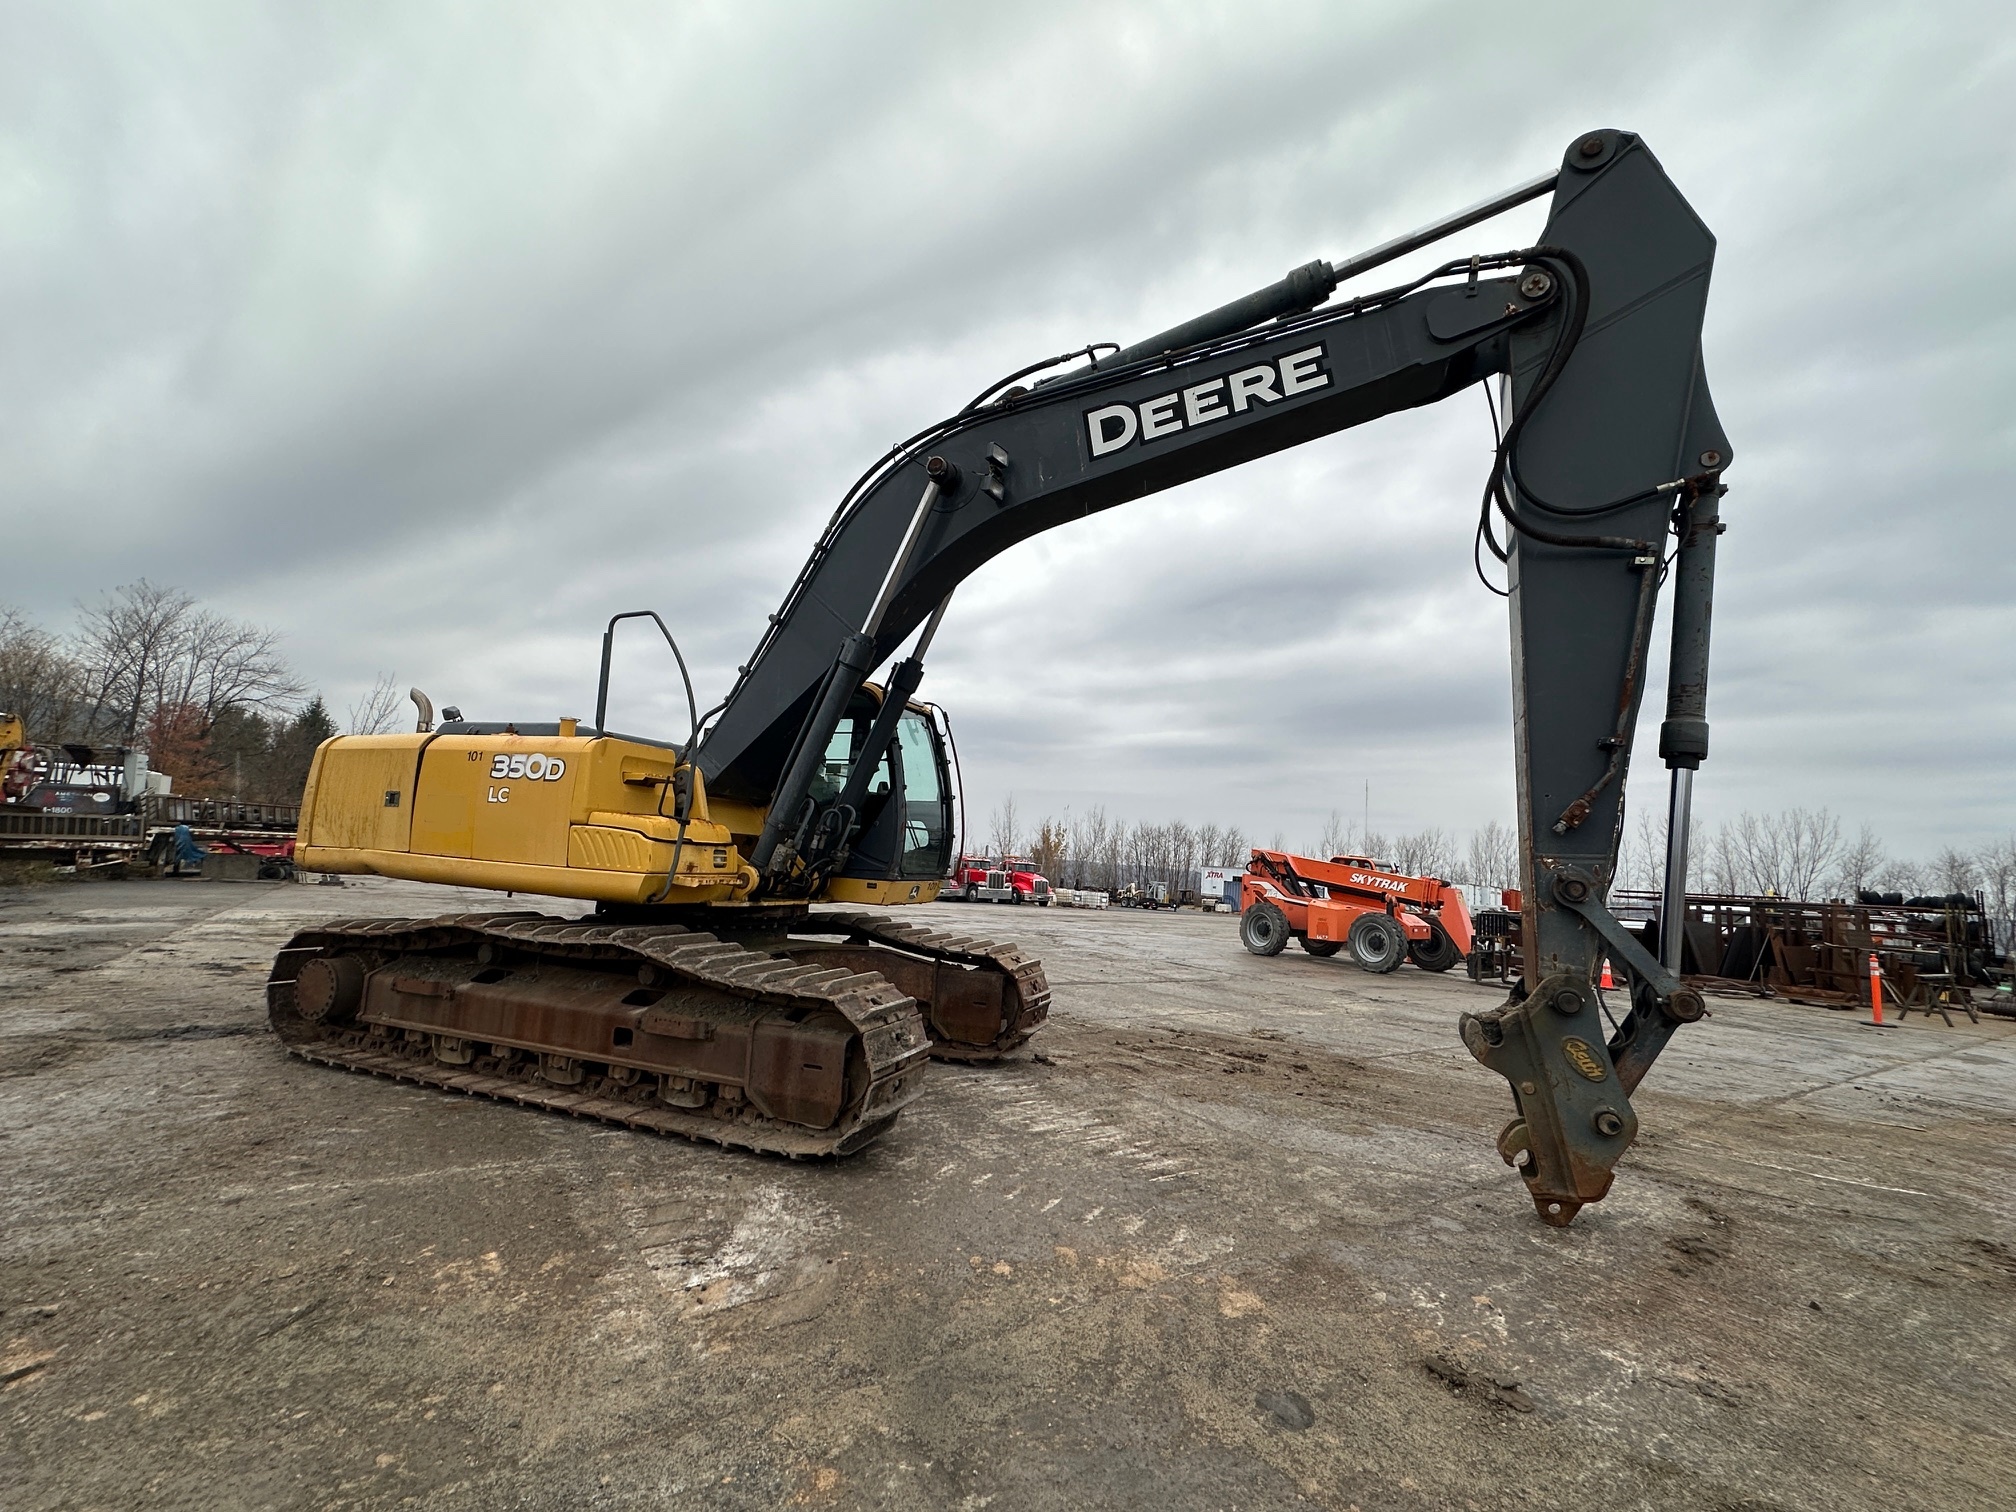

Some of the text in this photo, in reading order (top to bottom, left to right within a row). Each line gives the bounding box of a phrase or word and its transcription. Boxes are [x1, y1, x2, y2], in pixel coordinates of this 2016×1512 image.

[1087, 345, 1329, 457] DEERE
[467, 751, 484, 762] 101
[489, 752, 566, 782] 350D
[487, 786, 510, 803] LC
[1205, 870, 1224, 879] XTRA
[1349, 873, 1409, 893] SKYTRAK
